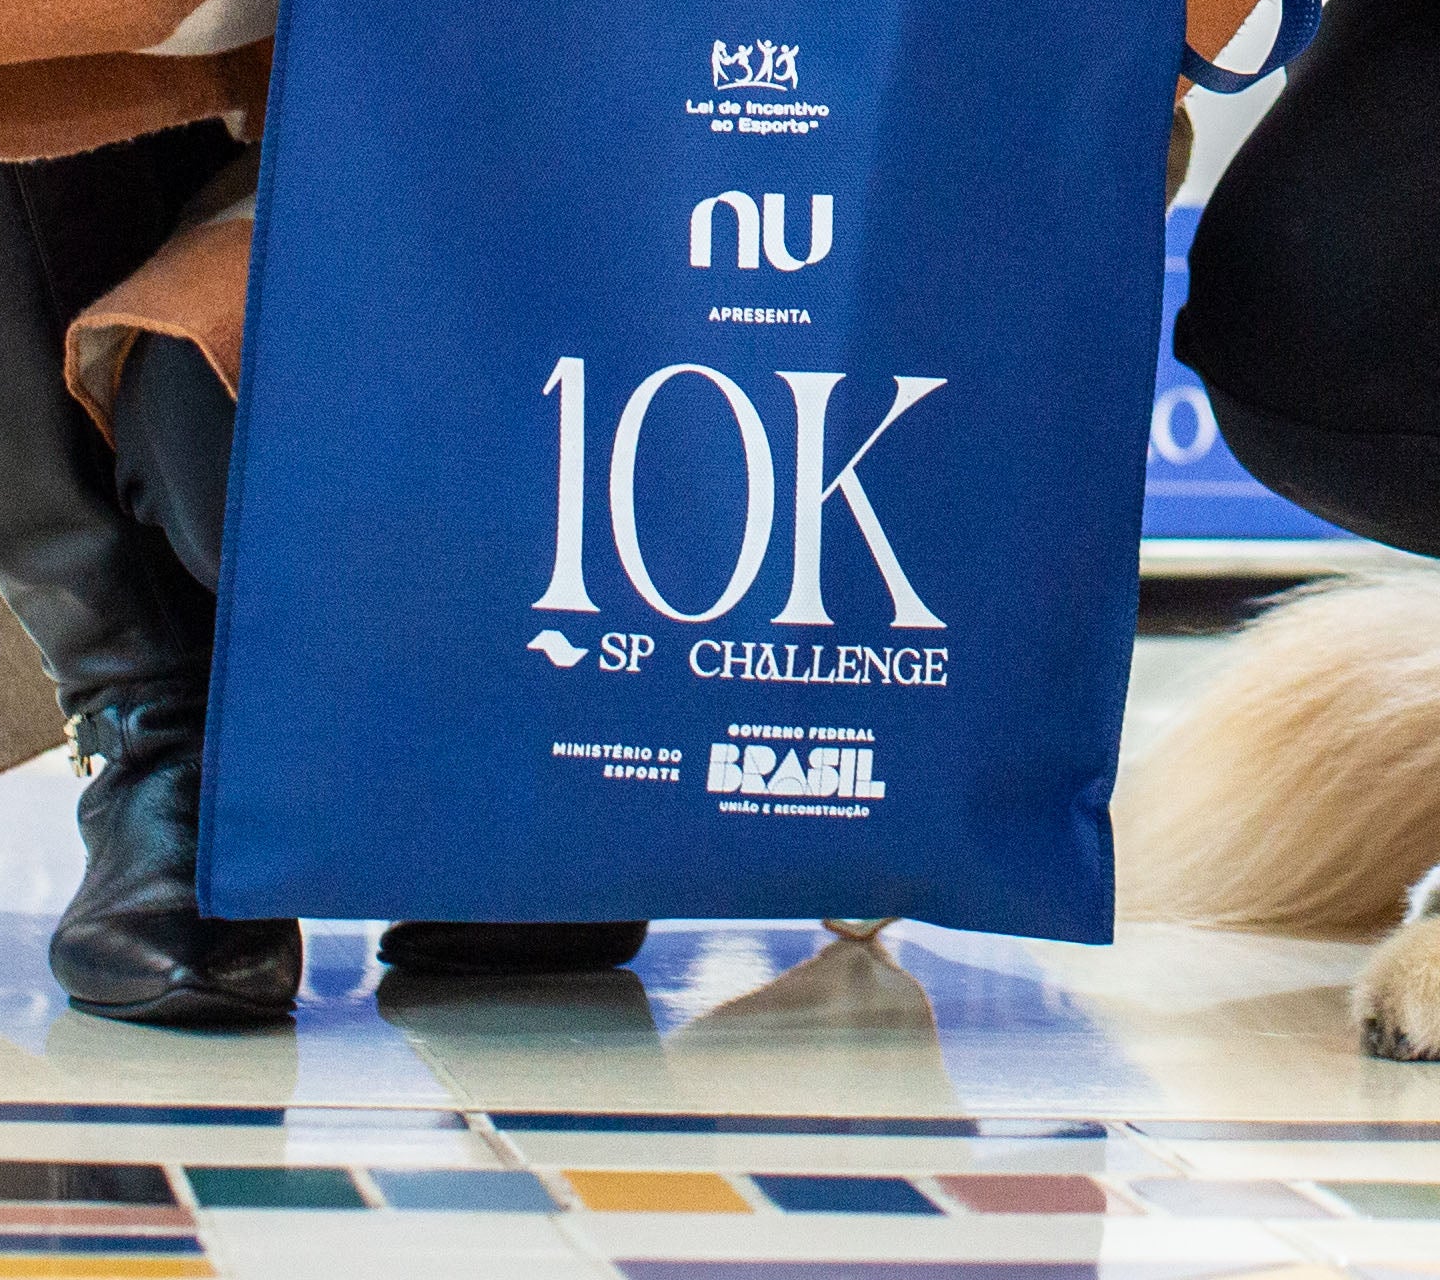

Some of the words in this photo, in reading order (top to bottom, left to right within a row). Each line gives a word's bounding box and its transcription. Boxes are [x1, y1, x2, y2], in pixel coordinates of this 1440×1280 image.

[685, 99, 714, 115] Lei
[718, 100, 742, 115] de
[746, 100, 830, 117] Incentivo
[689, 190, 835, 272] nu
[708, 306, 812, 325] APRESENTA
[531, 356, 949, 629] 10K
[599, 632, 656, 674] SP
[689, 638, 950, 687] CHALLENGE
[727, 723, 805, 740] GOVERNO
[809, 725, 877, 742] FEDERAL
[552, 741, 654, 762] MINISTÉRIO
[659, 747, 683, 763] DO
[602, 764, 681, 782] ESPORTE
[706, 742, 886, 800] BRASIL
[719, 800, 760, 814] UNIÃO
[762, 803, 771, 814] E
[774, 803, 871, 819] RECONSTRUÇÃO
